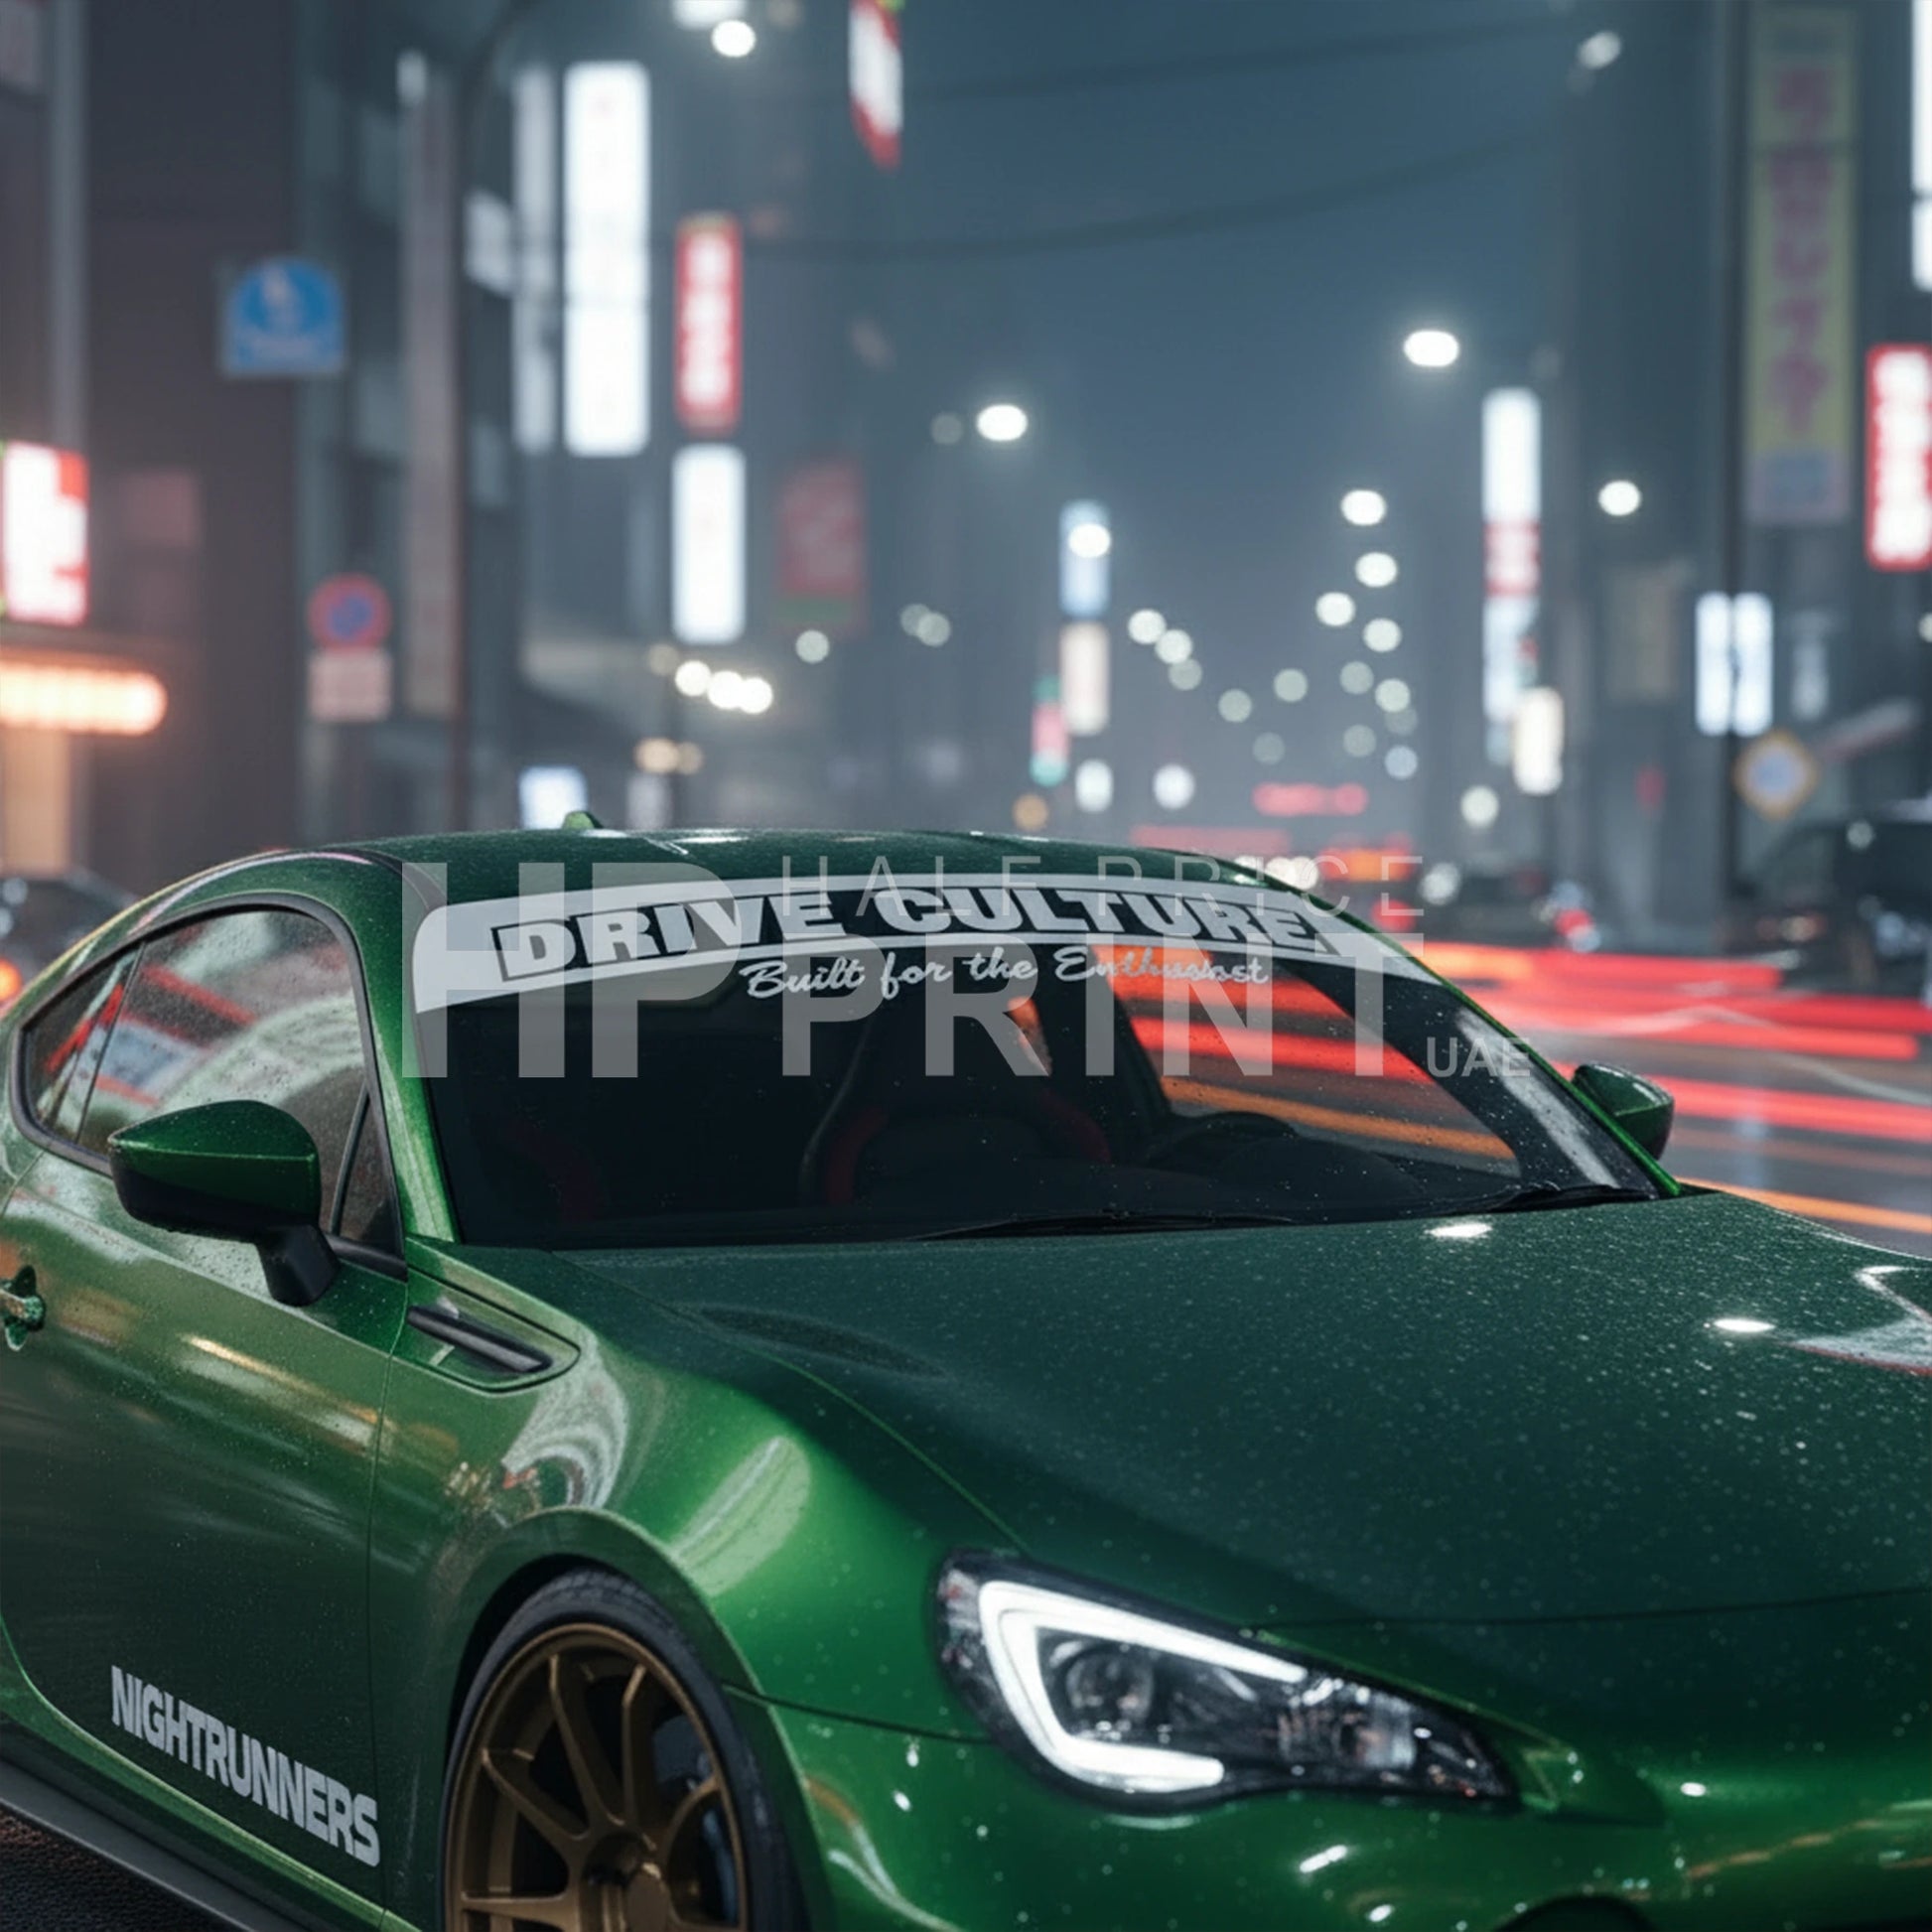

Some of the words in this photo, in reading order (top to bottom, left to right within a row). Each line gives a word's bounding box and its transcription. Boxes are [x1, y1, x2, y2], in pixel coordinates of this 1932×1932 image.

[496, 892, 847, 978] DRIVE
[874, 888, 1328, 953] CULTURE
[739, 956, 866, 999] Built
[880, 951, 952, 1000] for
[961, 946, 1038, 982] the
[111, 1665, 380, 1867] NIGHTRUNNERS
